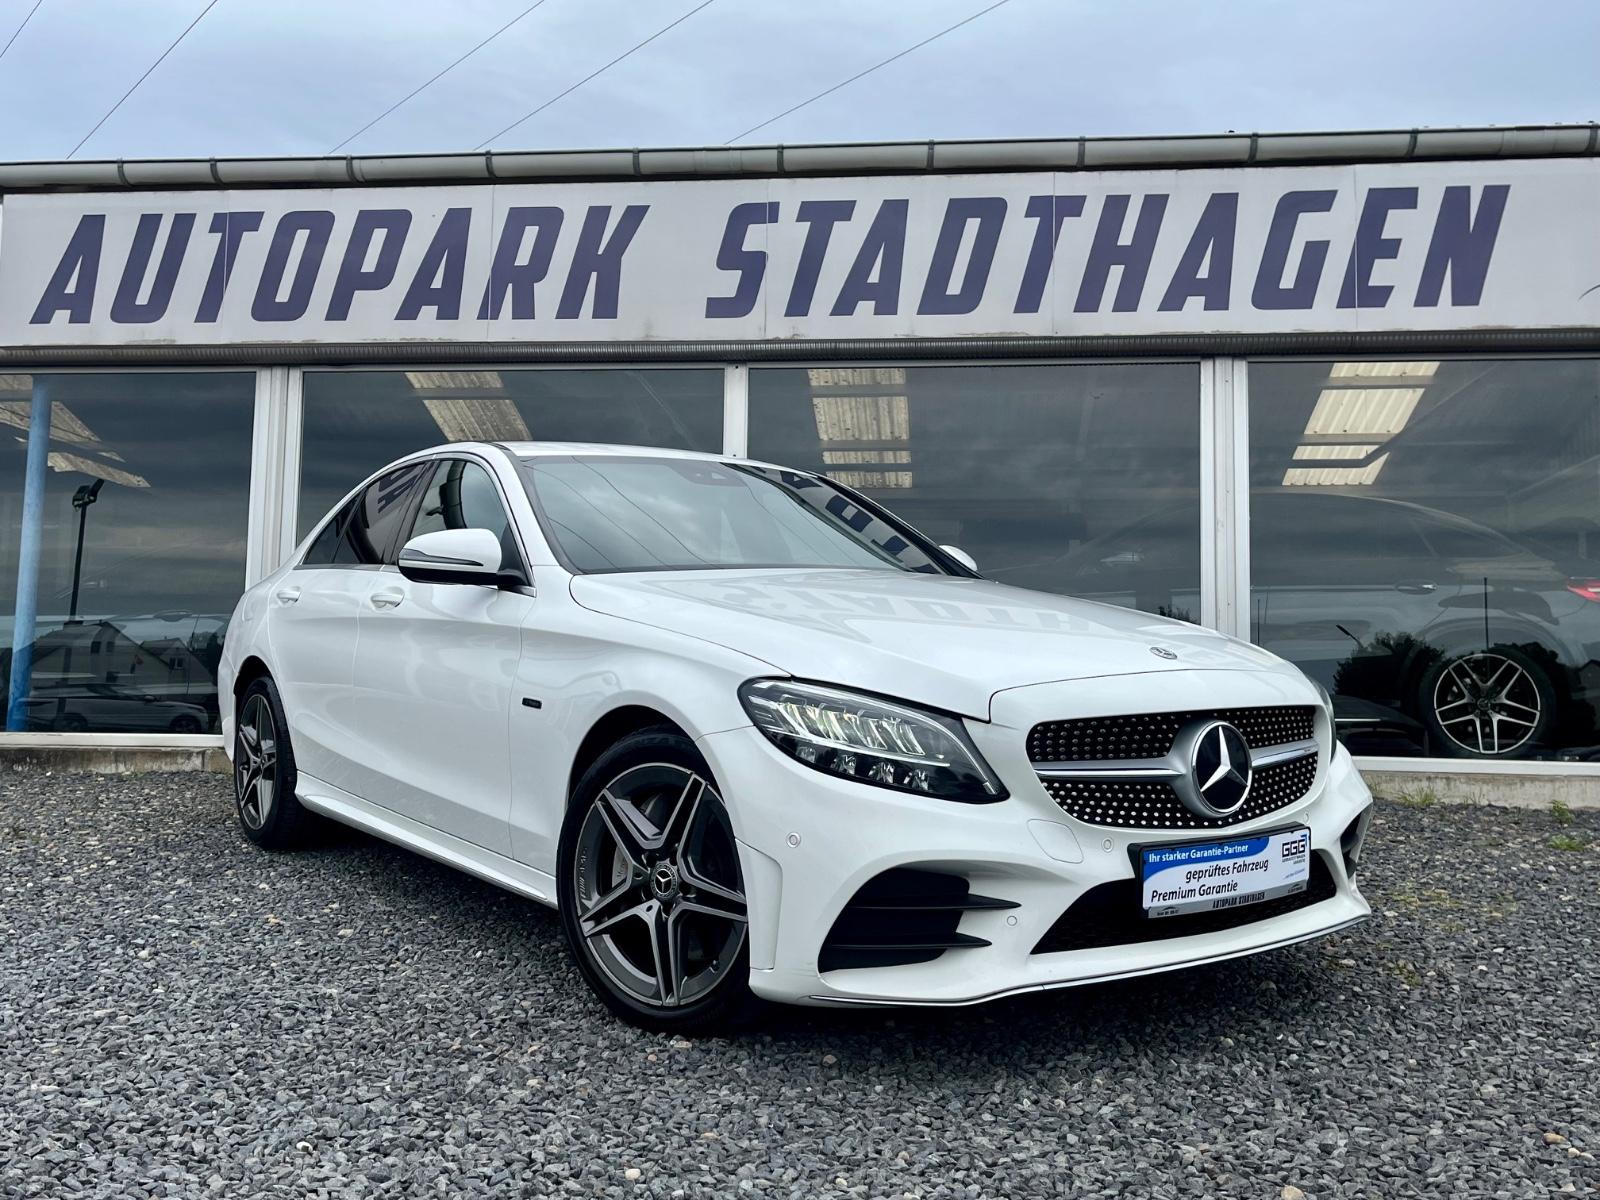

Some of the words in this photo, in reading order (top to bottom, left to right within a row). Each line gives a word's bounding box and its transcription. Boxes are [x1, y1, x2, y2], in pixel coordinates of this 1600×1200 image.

[29, 204, 651, 325] AUTOPARK
[705, 184, 1512, 319] STADTHAGEN
[1149, 852, 1161, 863] Ihr
[1161, 850, 1189, 862] starker
[1190, 843, 1249, 859] Garantie-Partner
[1281, 838, 1306, 858] GGG
[1185, 865, 1231, 883] geprüftes
[1231, 858, 1269, 876] Fahrzeug
[1151, 886, 1196, 903] Premium
[1198, 880, 1238, 897] Garantie
